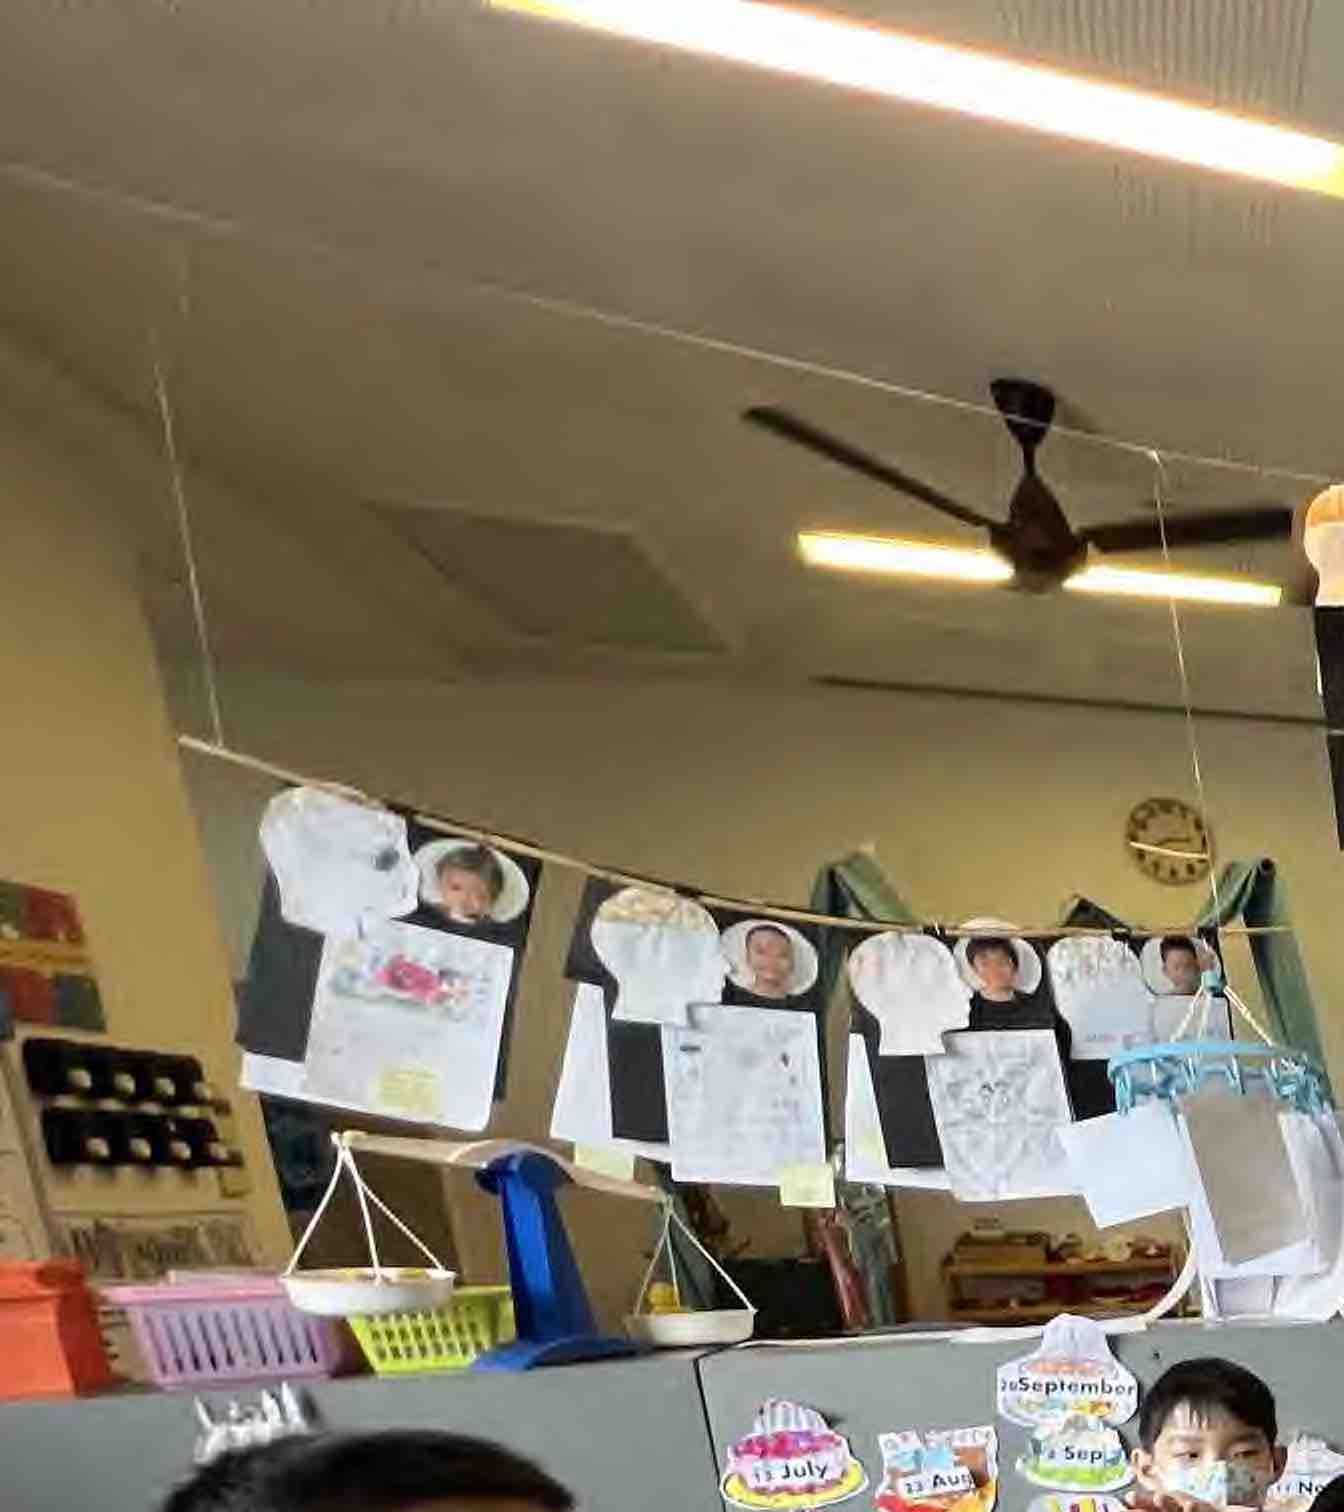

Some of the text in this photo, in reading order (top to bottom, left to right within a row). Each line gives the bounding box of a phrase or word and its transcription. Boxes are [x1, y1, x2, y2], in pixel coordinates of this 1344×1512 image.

[1018, 1376, 1135, 1395] September
[1064, 1445, 1103, 1464] Sep
[782, 1460, 828, 1479] July
